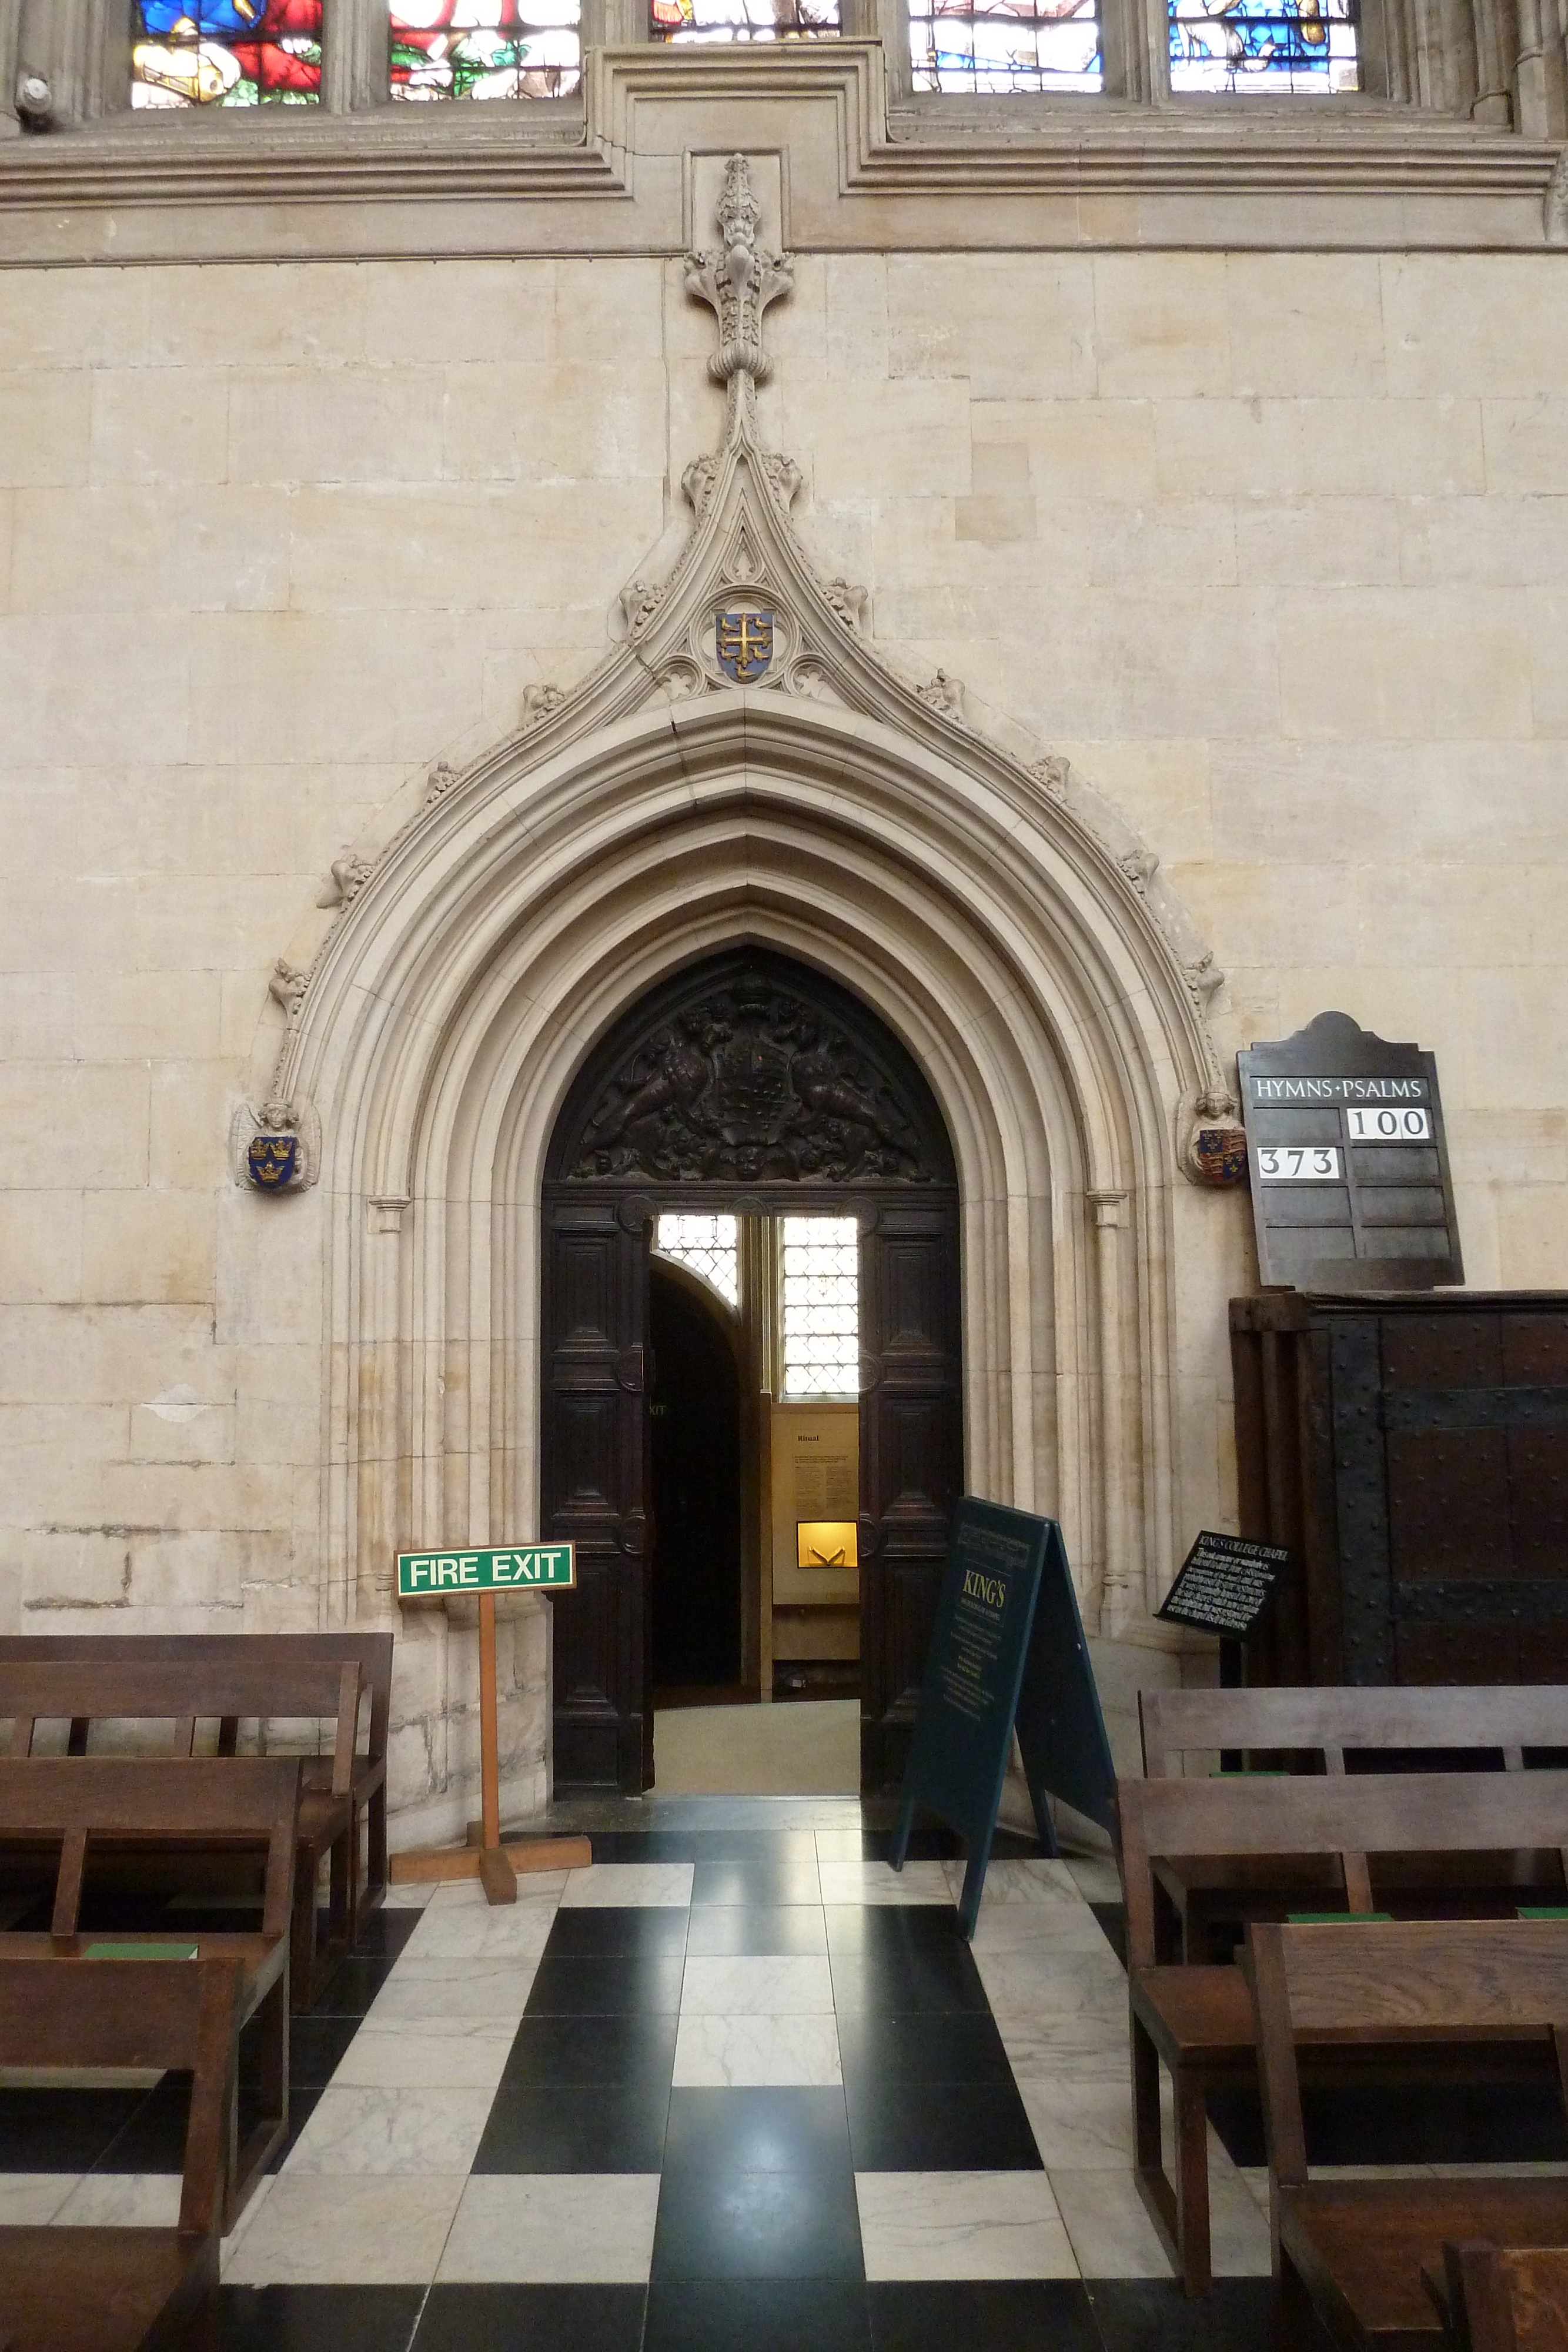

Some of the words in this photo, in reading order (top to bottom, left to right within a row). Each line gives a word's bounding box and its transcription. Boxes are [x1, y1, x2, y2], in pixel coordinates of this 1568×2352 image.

[1256, 1080, 1332, 1098] HYMNS
[1342, 1080, 1422, 1098] PSALMS
[1352, 1111, 1424, 1135] 100
[1261, 1149, 1332, 1177] 373
[1225, 1539, 1260, 1556] COLLEGE
[1259, 1547, 1288, 1561] CHAPEL
[410, 1556, 479, 1587] FIRE
[492, 1552, 561, 1581] EXIT
[962, 1569, 1006, 1608] KING'S
